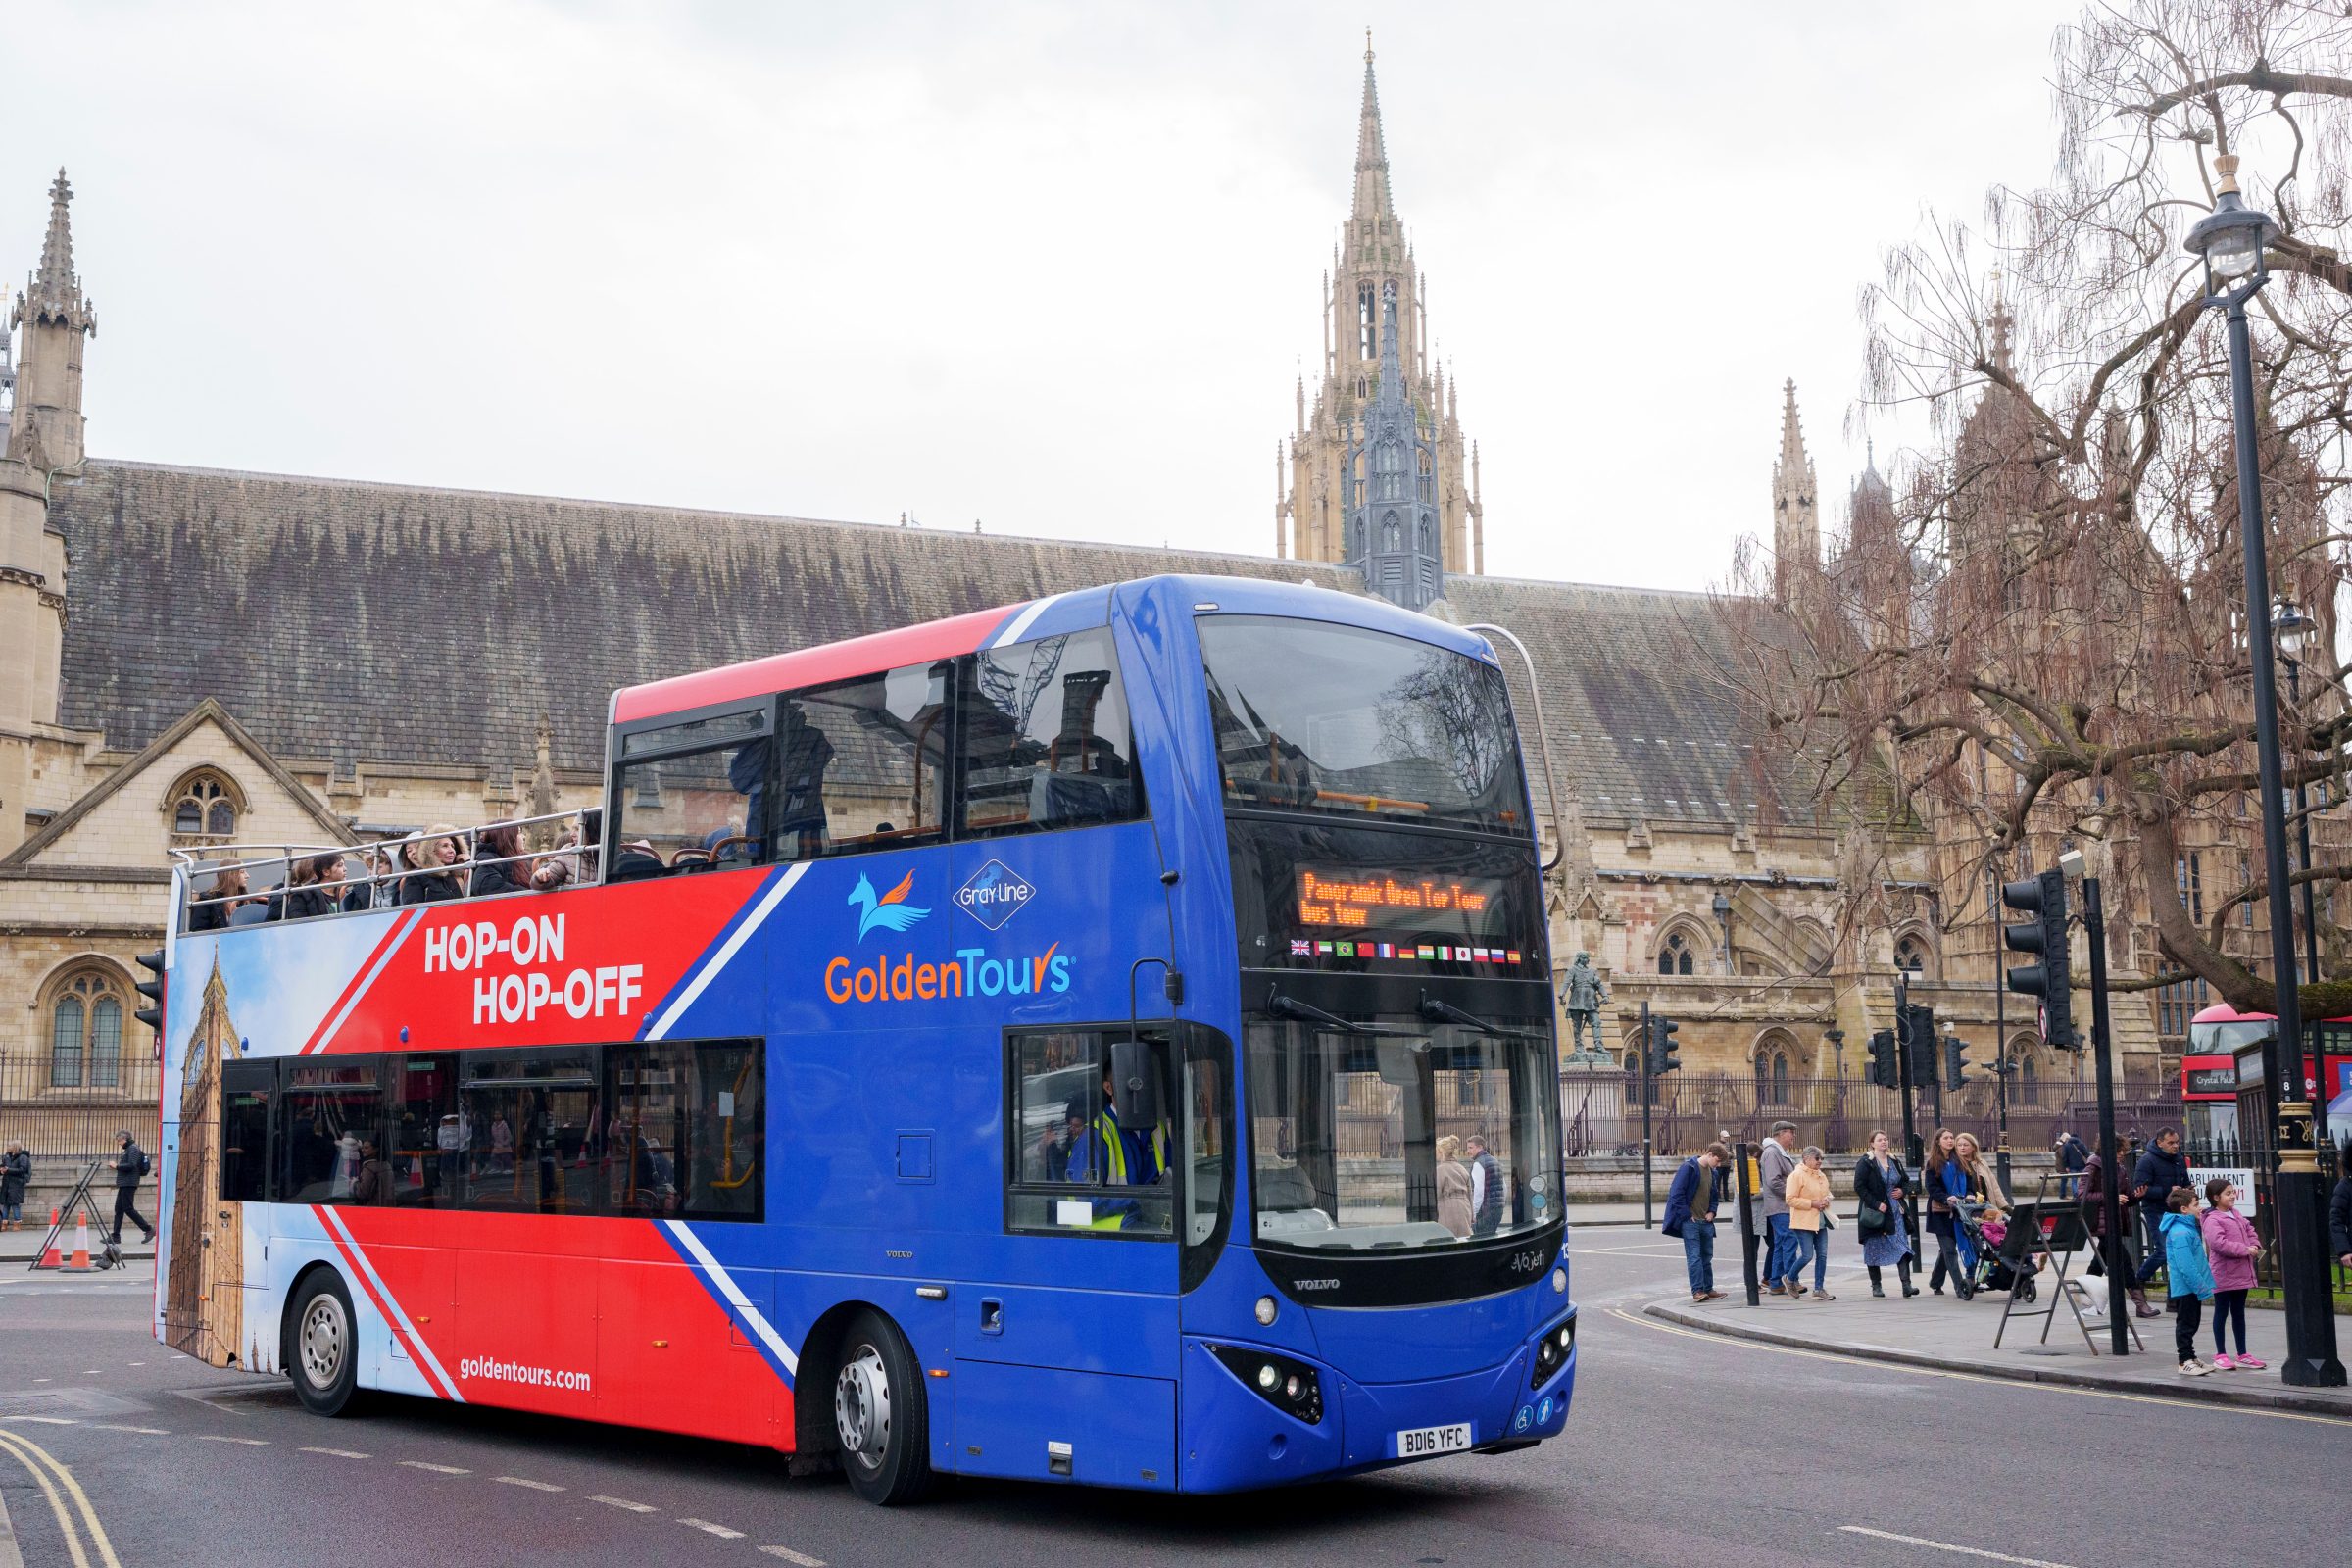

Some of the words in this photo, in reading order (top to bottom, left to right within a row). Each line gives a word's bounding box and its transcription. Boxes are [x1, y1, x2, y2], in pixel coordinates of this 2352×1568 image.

[424, 912, 565, 973] HOP-ON
[473, 964, 643, 1025] HOP-OFF
[2196, 1075, 2220, 1086] Crystal
[2220, 1075, 2235, 1084] Palac
[2283, 1081, 2290, 1091] 8
[2189, 1173, 2245, 1186] ARLIENT
[1294, 1278, 1341, 1291] VOLVO
[460, 1355, 591, 1392] goldentours.com
[1405, 1431, 1436, 1453] BD16
[1438, 1427, 1463, 1448] YFC
